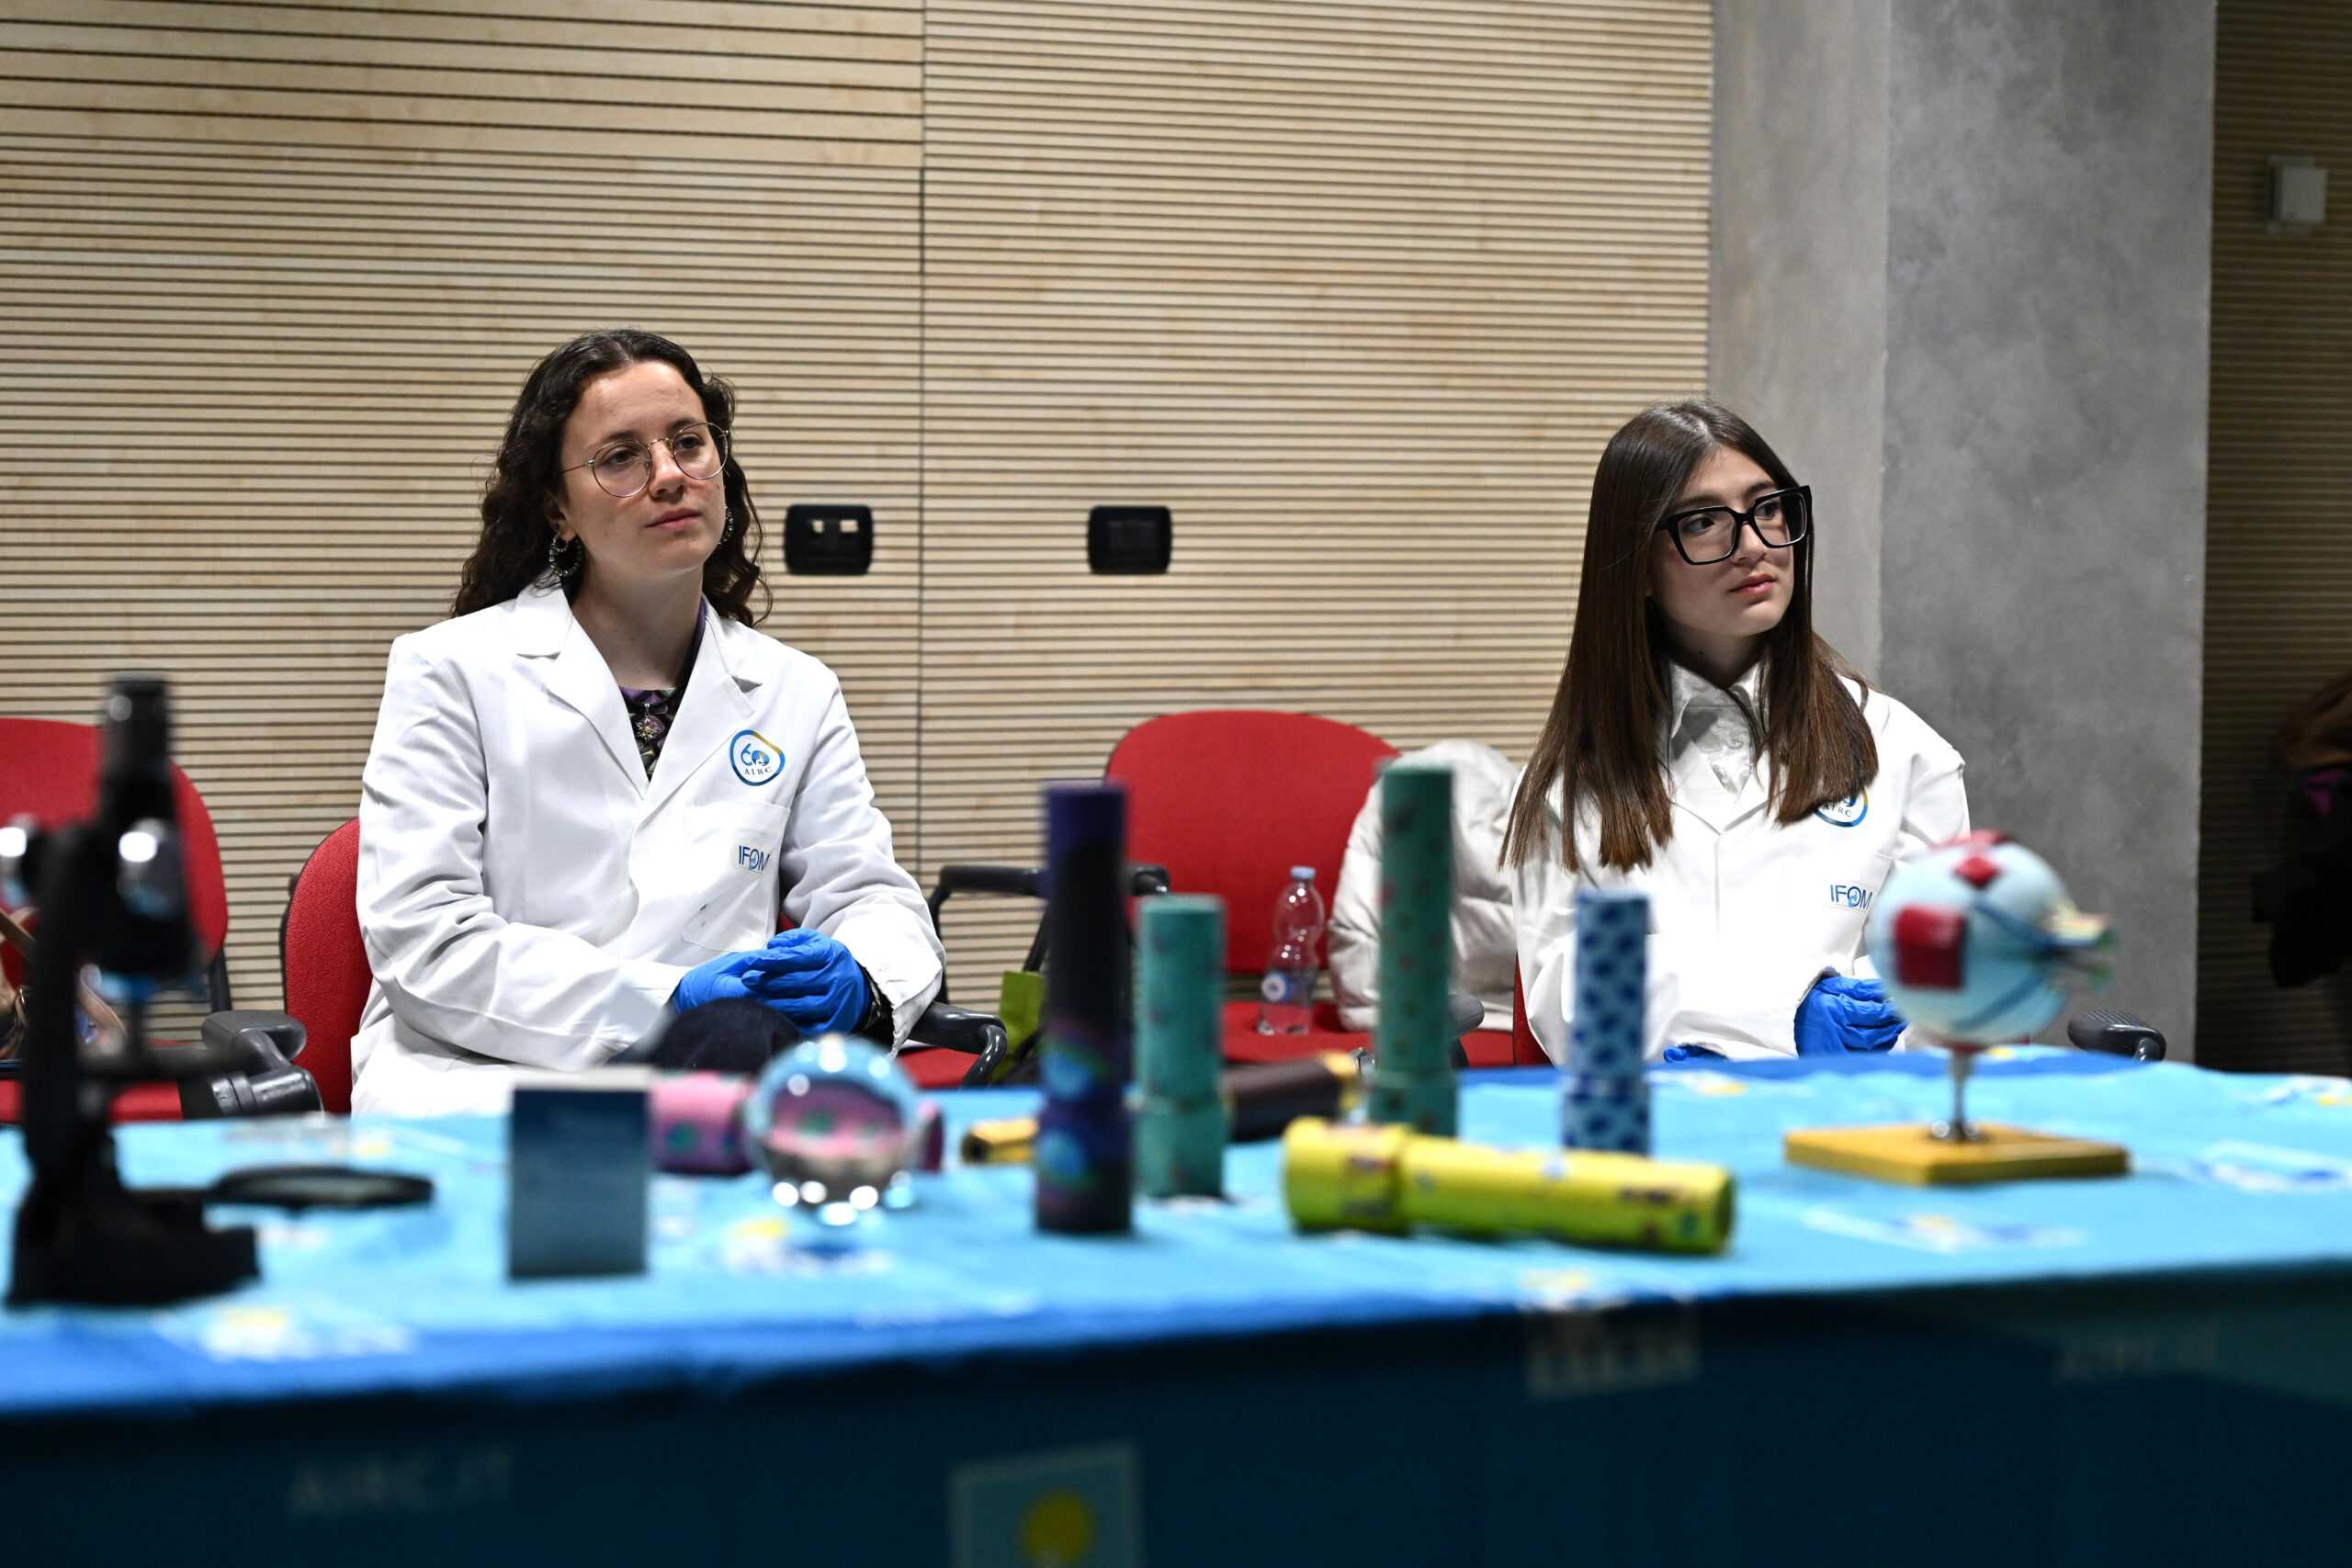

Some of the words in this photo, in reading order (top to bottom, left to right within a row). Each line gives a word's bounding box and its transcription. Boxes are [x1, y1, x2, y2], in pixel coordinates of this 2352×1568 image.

[744, 767, 773, 775] AIRC
[739, 845, 770, 872] IFOM
[1830, 885, 1873, 910] IFOM
